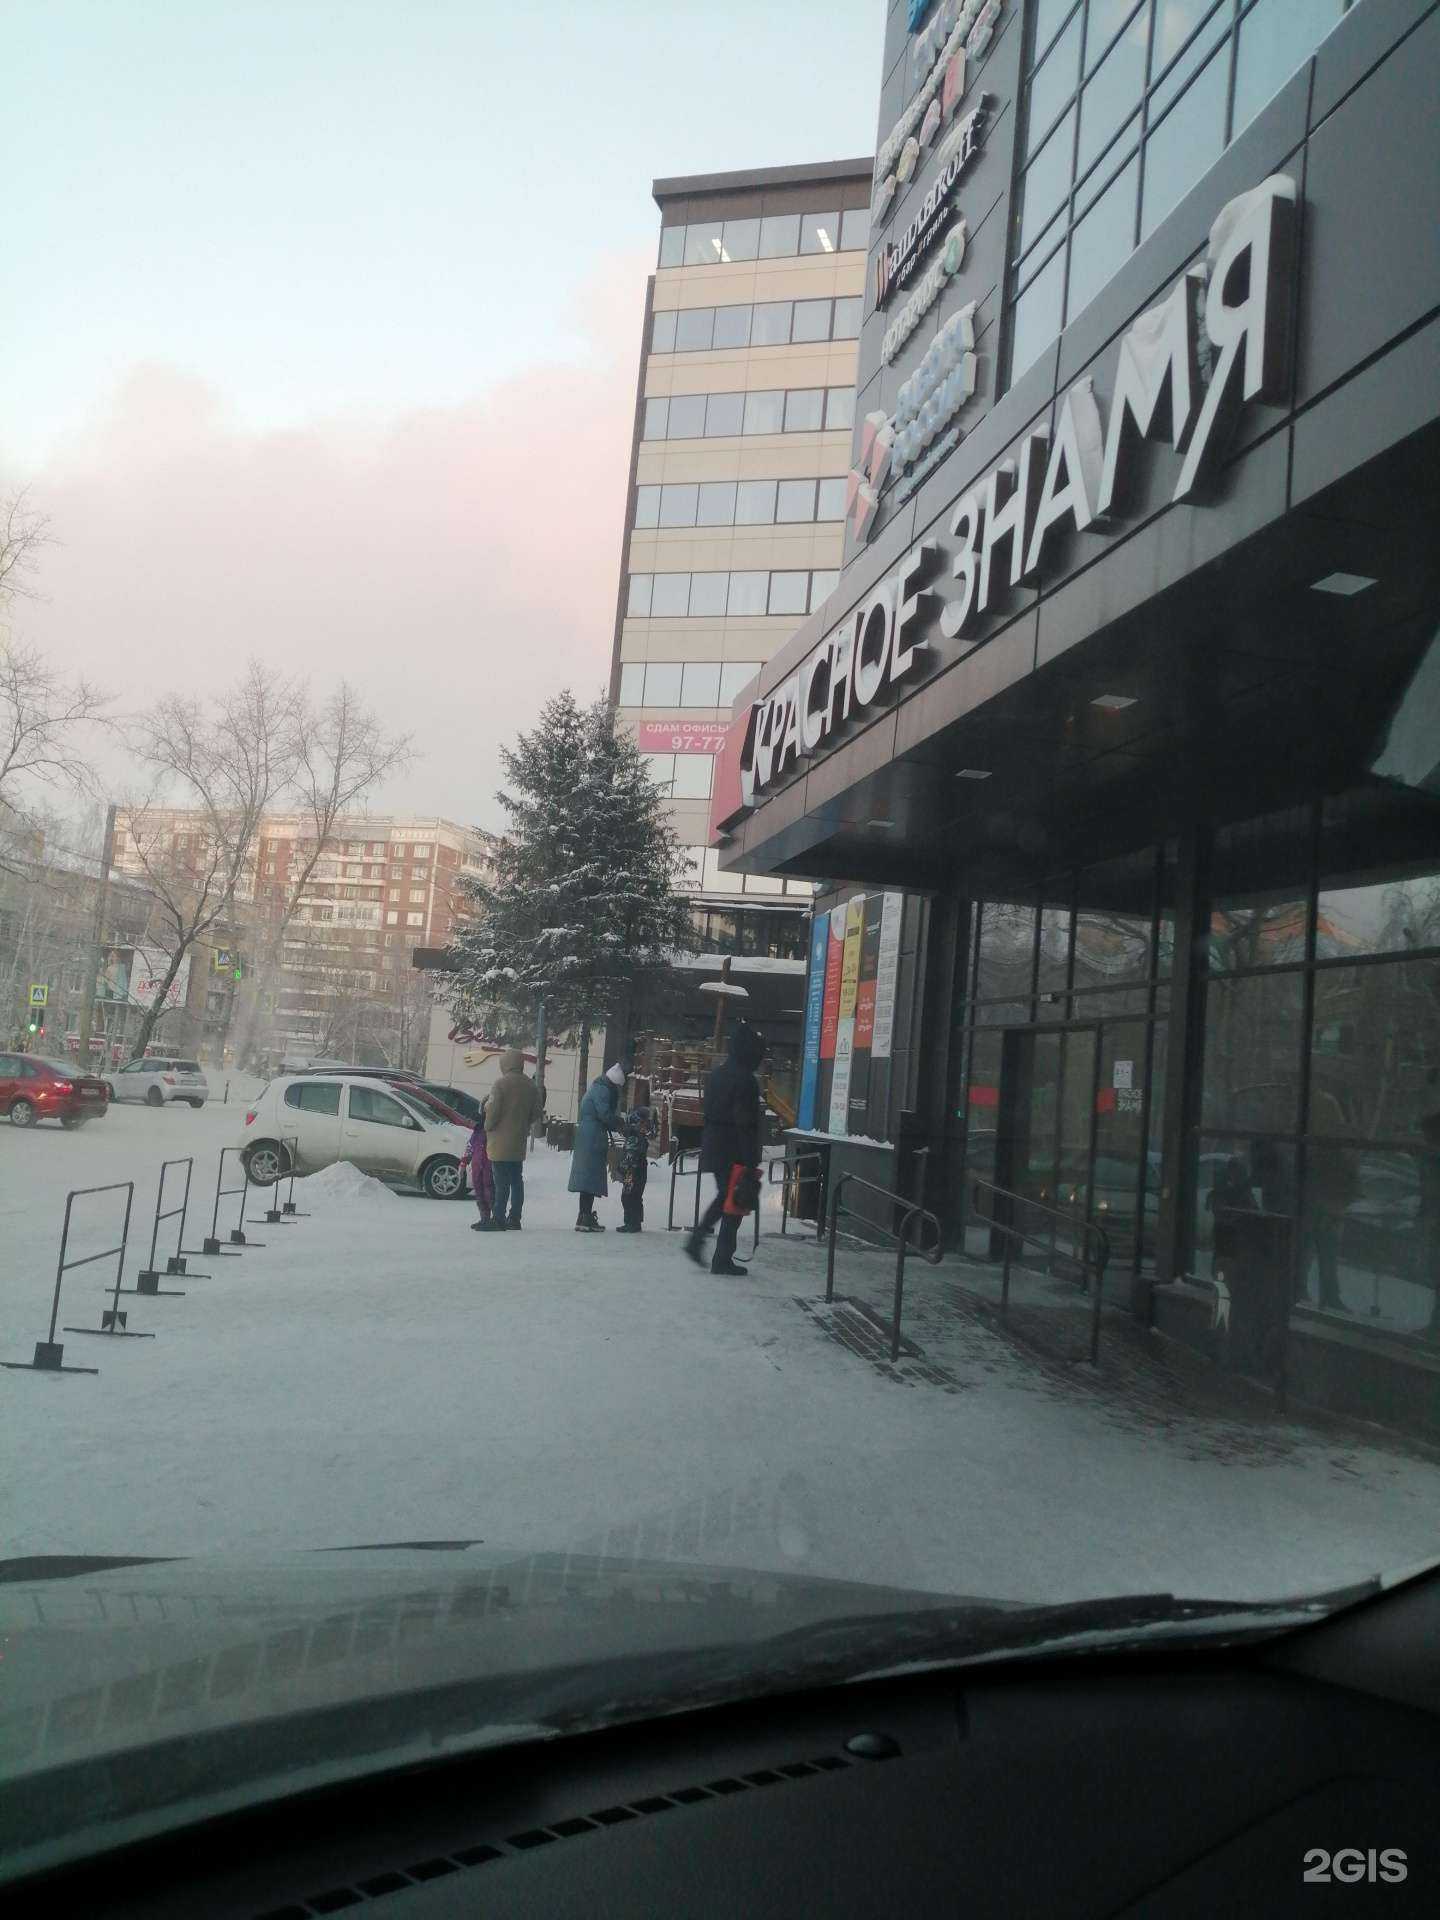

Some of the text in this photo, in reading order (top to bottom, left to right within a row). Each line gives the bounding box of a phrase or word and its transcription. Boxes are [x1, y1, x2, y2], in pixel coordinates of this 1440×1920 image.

[750, 180, 1275, 794] КРАСНОЕ ЗНАМЯ
[646, 723, 730, 734] СДАМ ОФИСЫ
